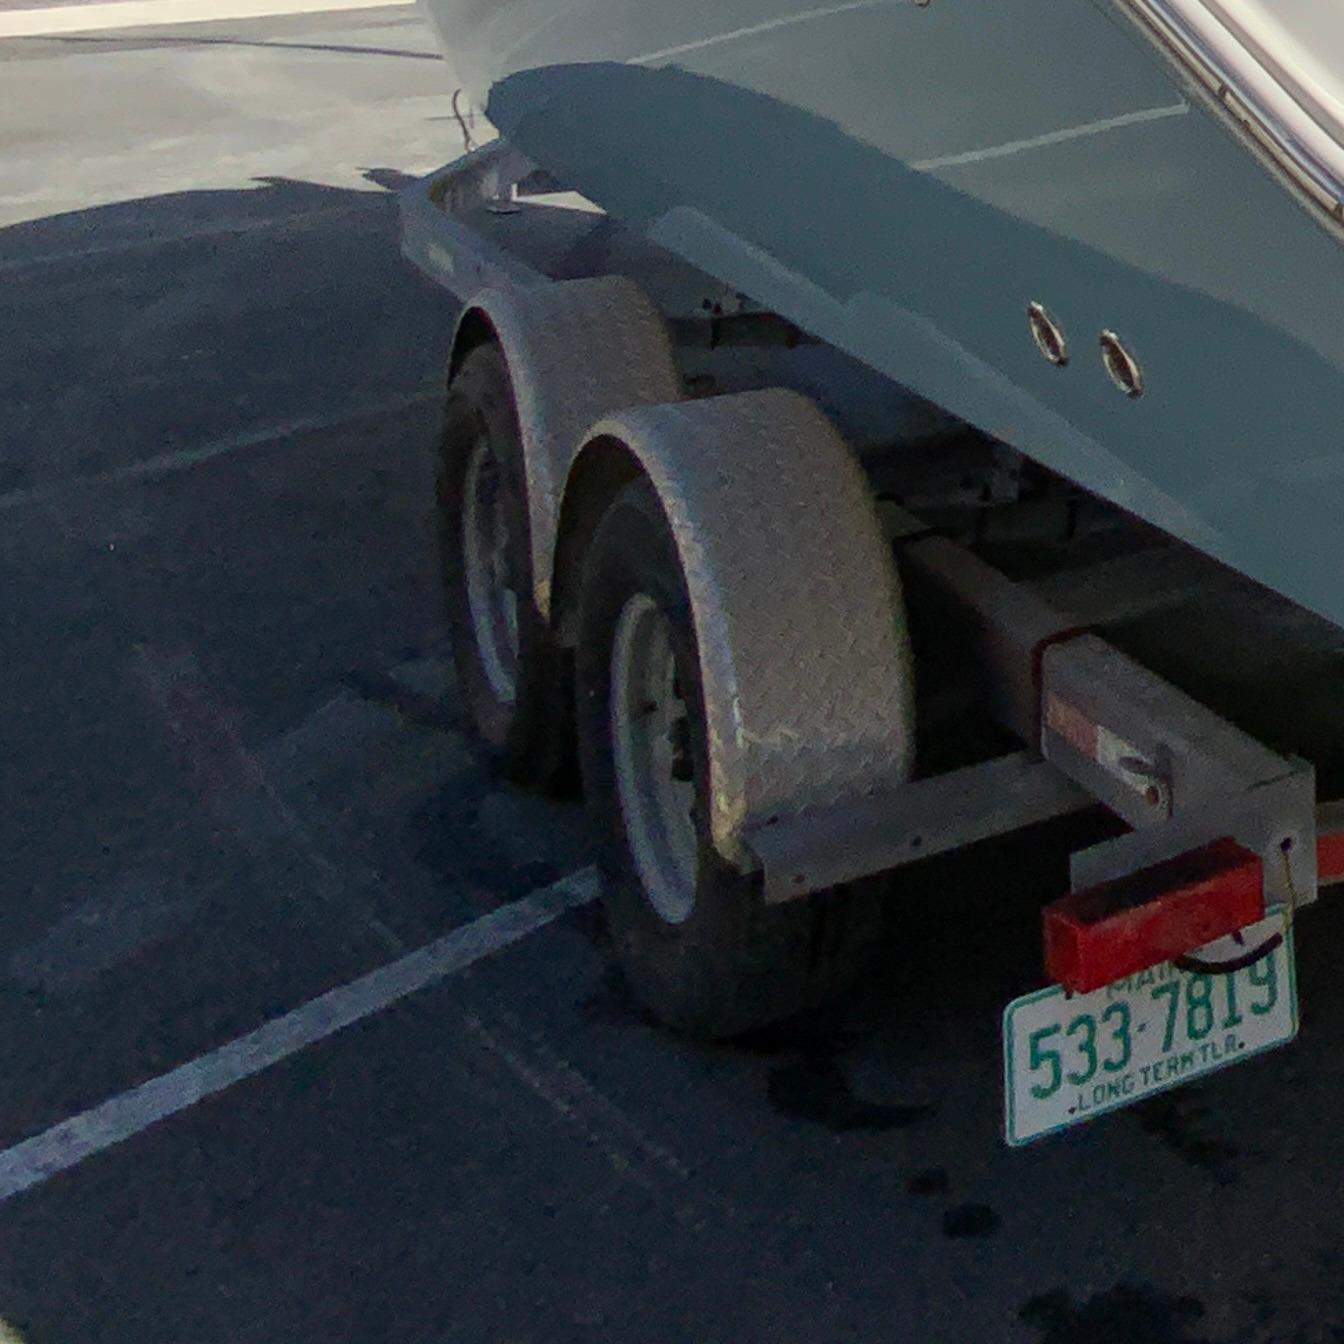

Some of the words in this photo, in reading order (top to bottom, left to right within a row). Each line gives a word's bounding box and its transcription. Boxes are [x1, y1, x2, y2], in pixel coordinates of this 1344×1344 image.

[1028, 951, 1279, 1100] 533-7819
[1076, 1073, 1136, 1111] LONG
[1139, 1051, 1195, 1086] TERM
